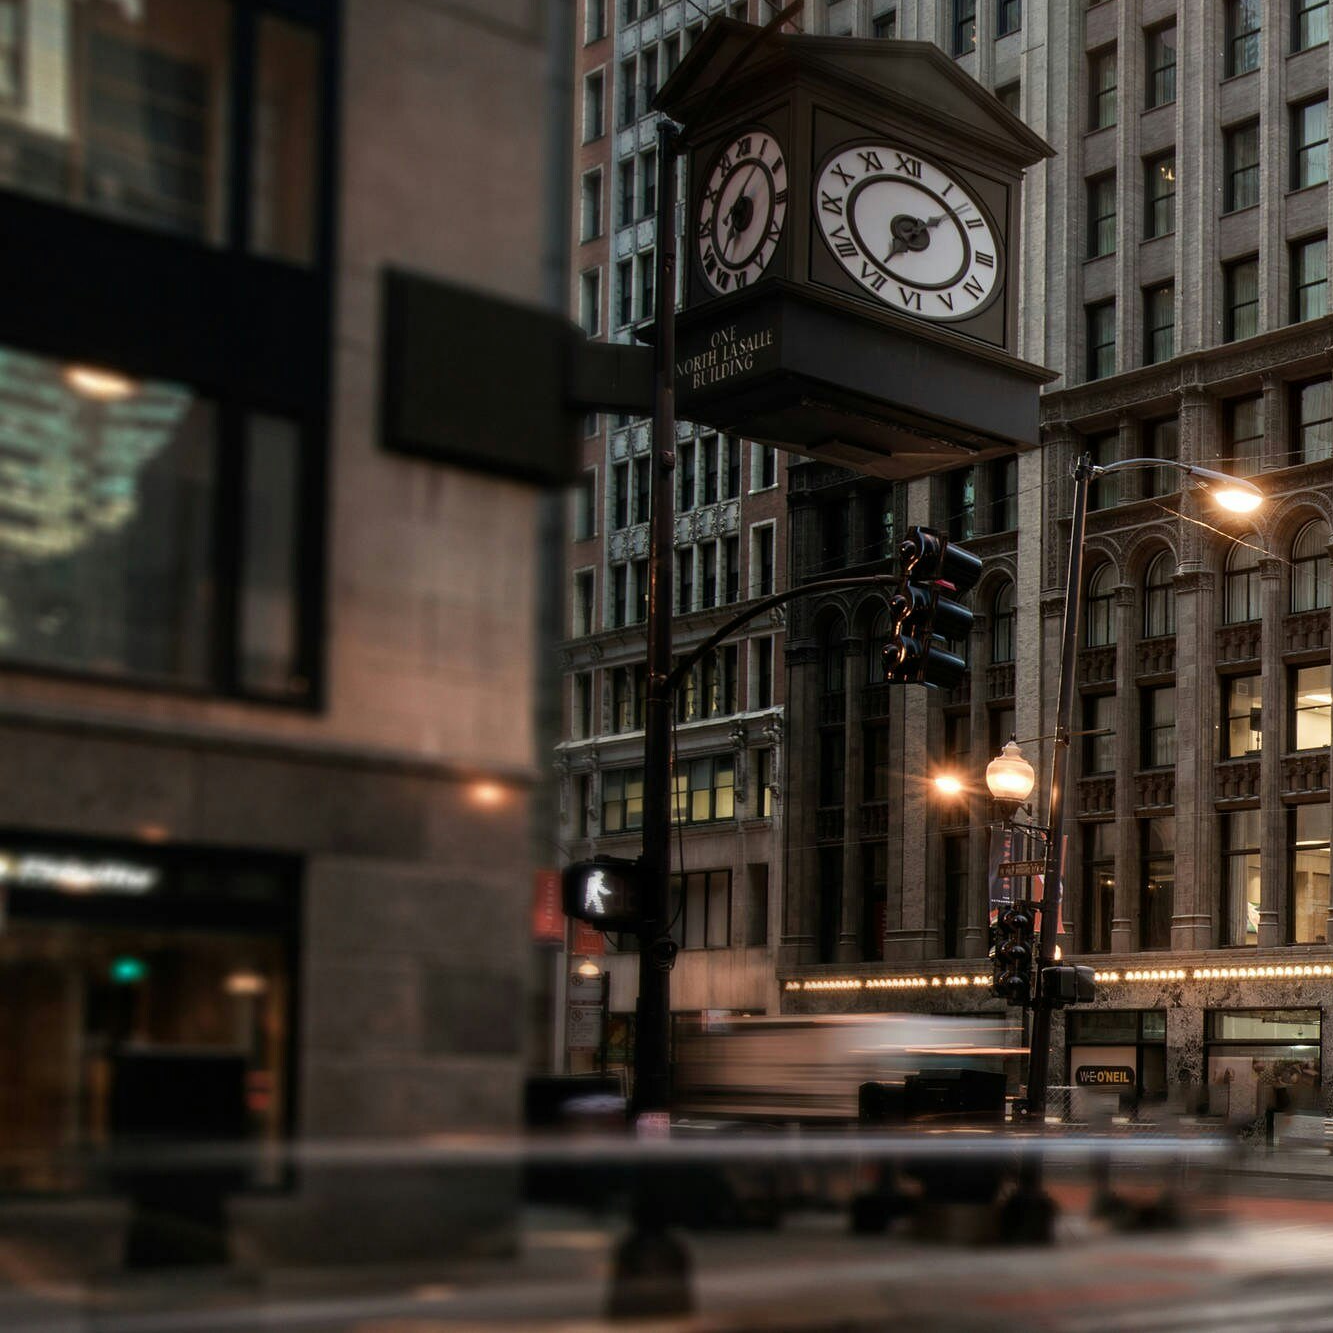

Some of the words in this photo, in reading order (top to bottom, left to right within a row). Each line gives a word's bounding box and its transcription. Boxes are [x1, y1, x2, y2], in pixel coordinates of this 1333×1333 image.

[760, 138, 768, 156] I
[857, 151, 883, 172] XI
[896, 153, 922, 179] XII
[831, 163, 855, 187] X
[941, 182, 954, 197] I
[822, 191, 843, 216] IX
[965, 218, 984, 229] II
[829, 225, 859, 258] VIII
[975, 250, 993, 268] III
[861, 261, 888, 292] VII
[963, 275, 984, 300] IV
[899, 287, 922, 310] VI
[937, 292, 954, 311] V
[711, 325, 736, 347] ONE
[677, 349, 717, 377] NORTH
[693, 354, 753, 389] BUILDING
